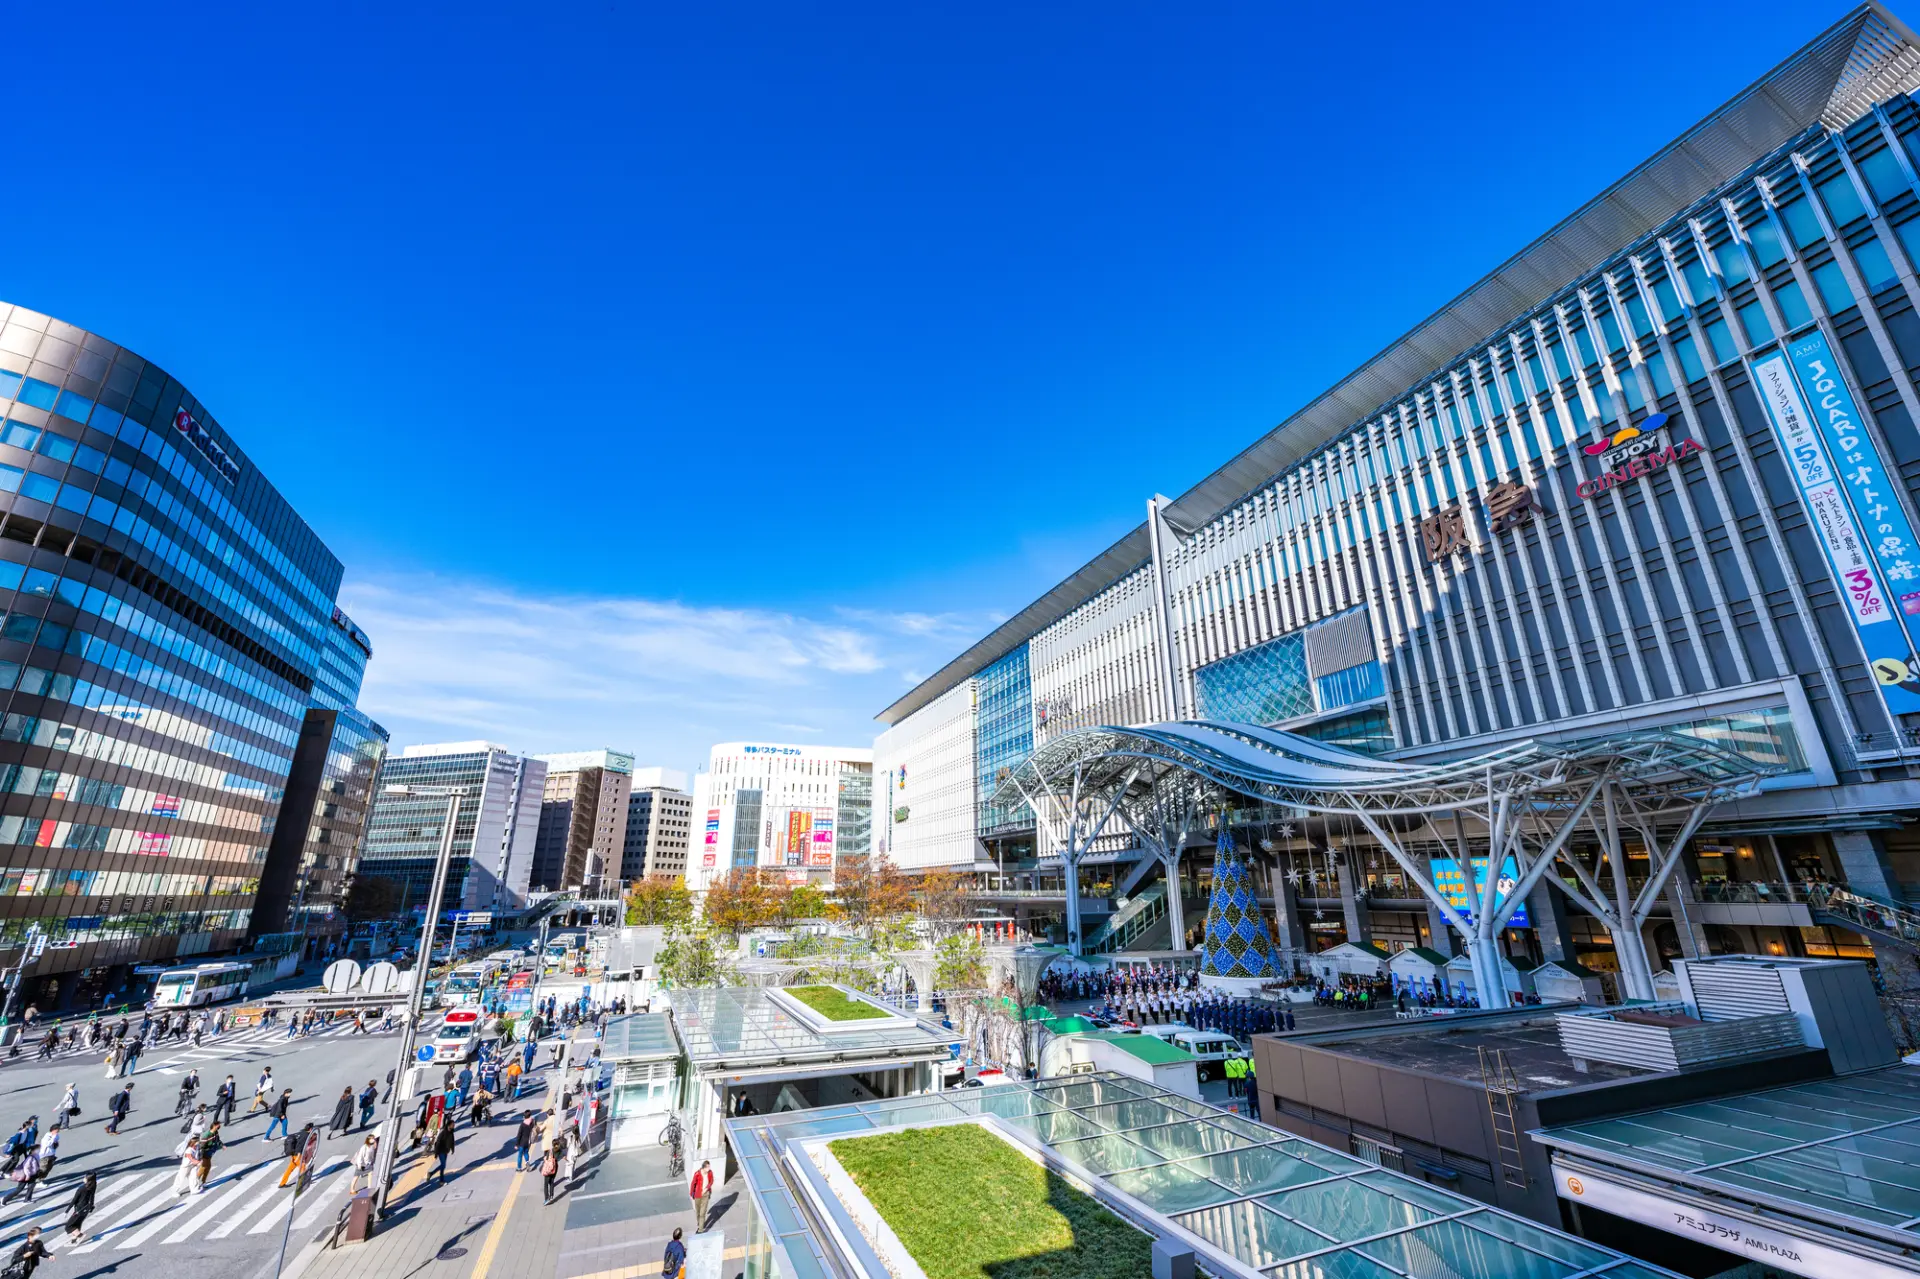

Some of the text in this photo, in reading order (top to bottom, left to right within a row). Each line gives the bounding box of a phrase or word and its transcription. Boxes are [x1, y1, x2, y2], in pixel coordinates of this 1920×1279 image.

[1795, 341, 1820, 357] AMU
[187, 420, 240, 484] Rakuten
[1576, 437, 1704, 499] CINEMA
[1806, 471, 1824, 482] OFF
[1860, 605, 1882, 616] OFF
[744, 746, 801, 755] 博多バスターミナル
[1674, 1213, 1802, 1263] アミュプラザ AMU PLAZA
